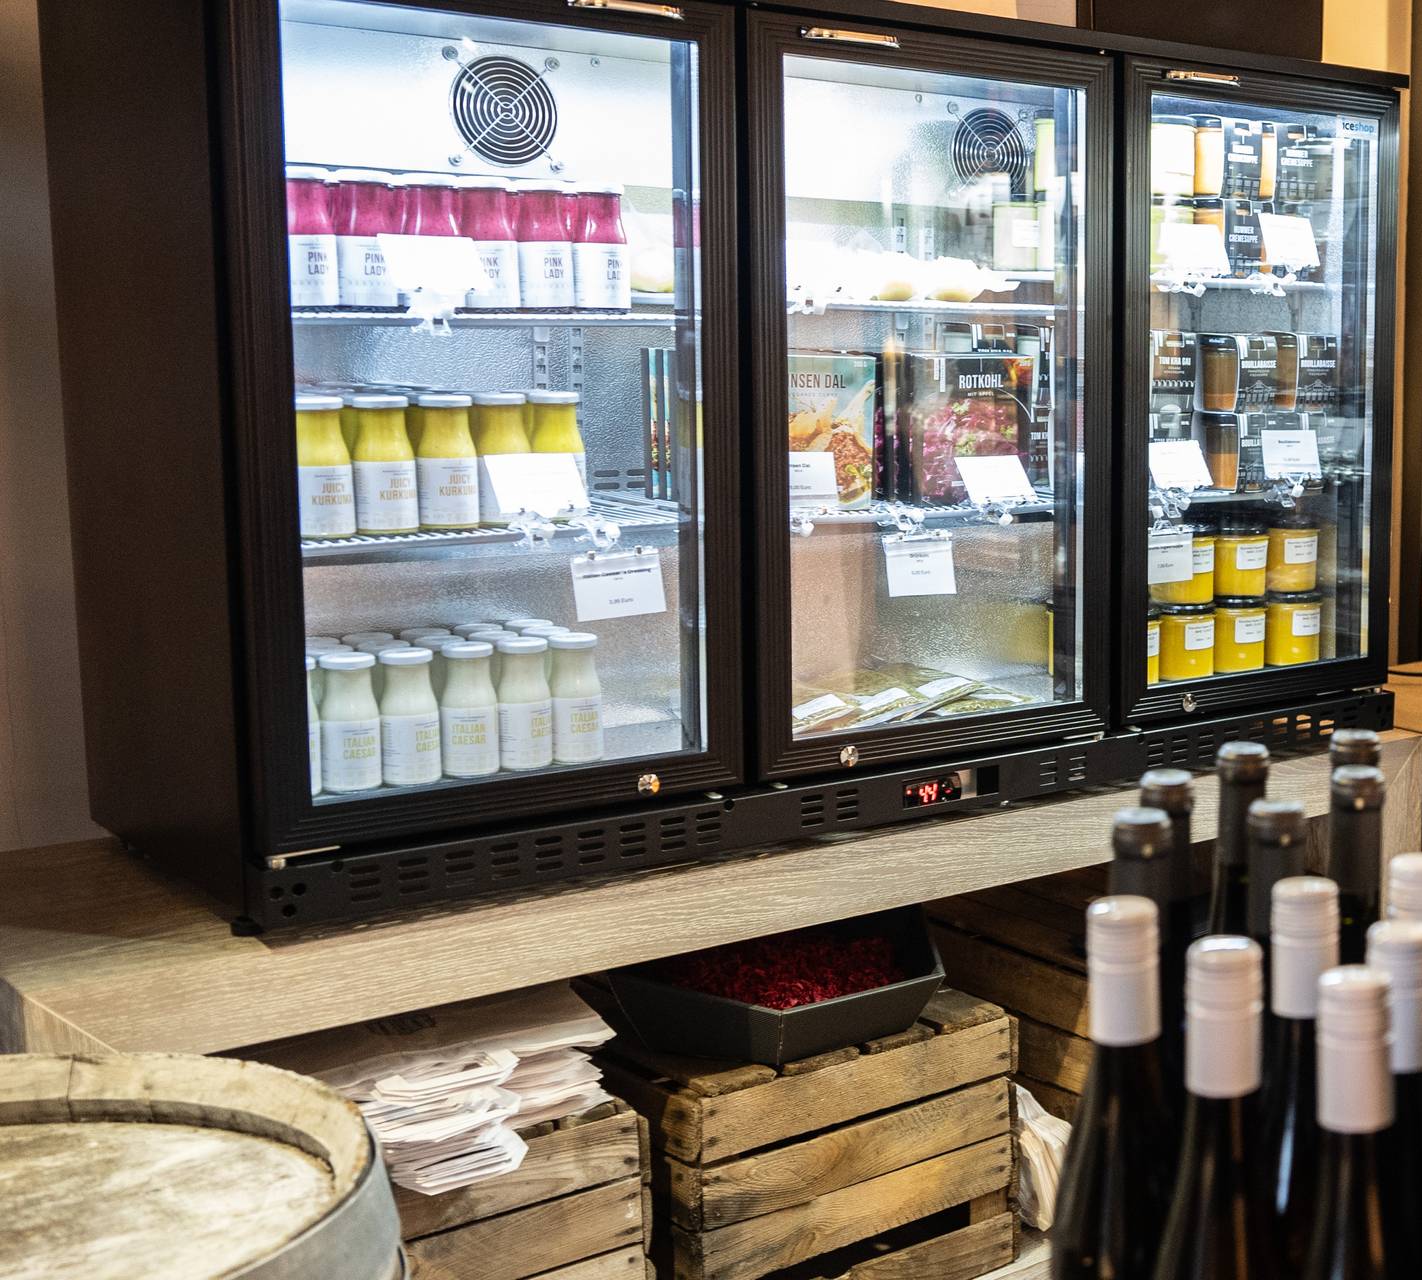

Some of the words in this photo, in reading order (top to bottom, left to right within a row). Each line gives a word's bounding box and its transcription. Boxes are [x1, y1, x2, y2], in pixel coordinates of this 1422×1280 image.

[365, 253, 385, 264] PINK
[544, 257, 563, 268] PINK
[364, 265, 387, 276] LADY
[544, 269, 564, 279] LADY
[607, 270, 621, 280] LAD
[825, 374, 847, 388] DAL
[959, 373, 1004, 389] ROTKOHL
[390, 478, 411, 488] JUICY
[449, 473, 470, 484] JUICY
[322, 483, 345, 494] JUICY
[452, 723, 486, 734] ITALIAN
[452, 735, 486, 746] CAESAR
